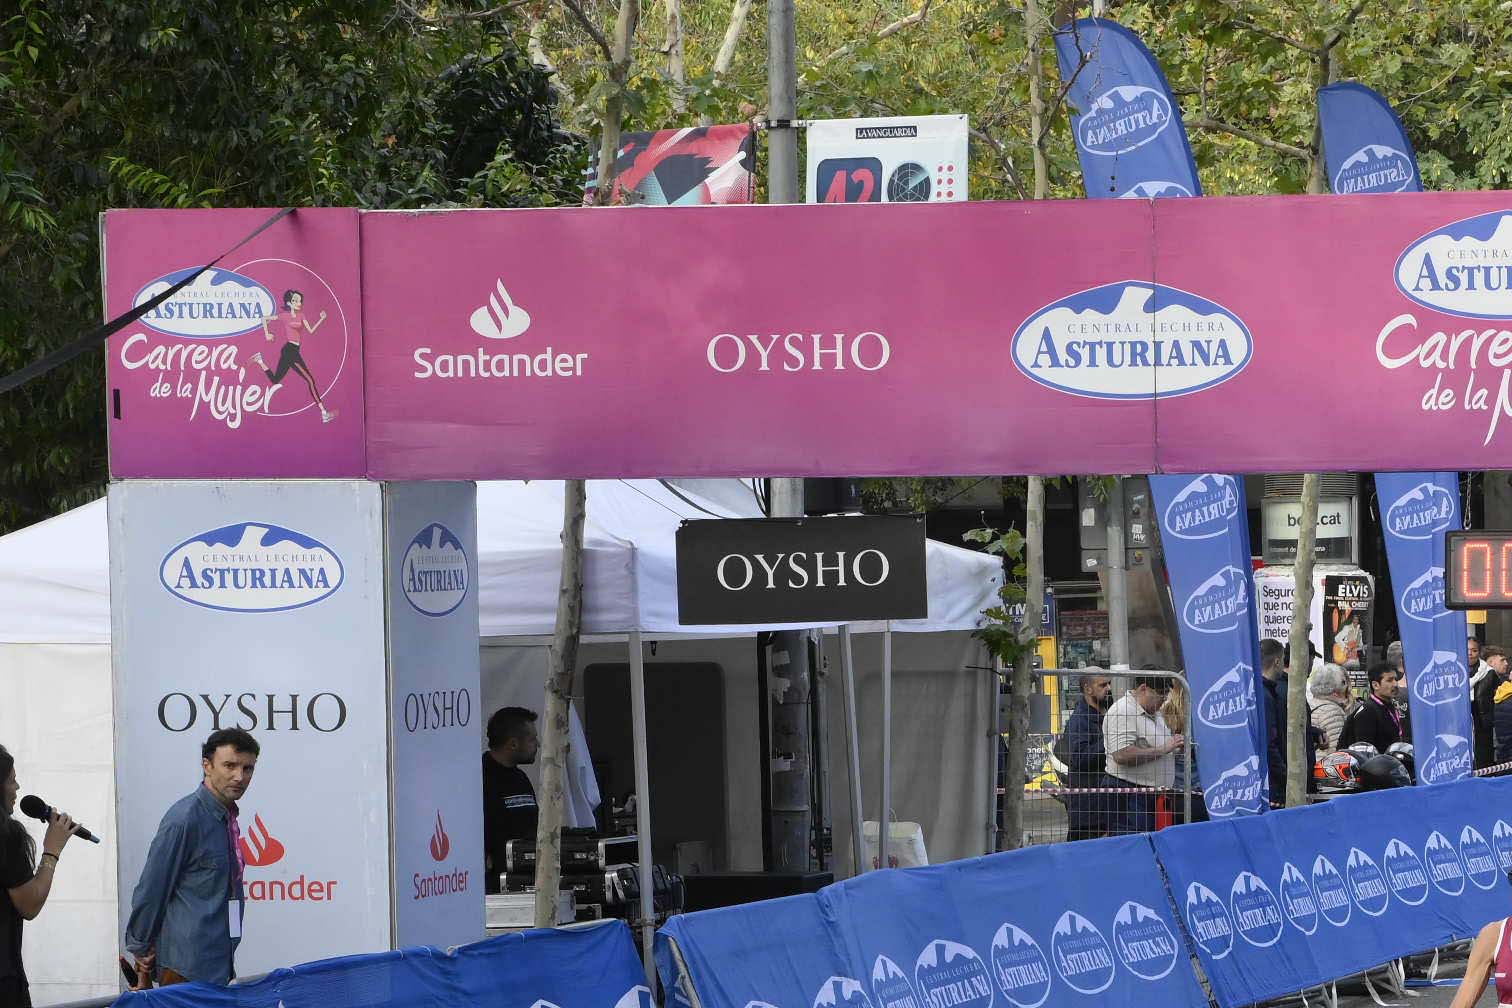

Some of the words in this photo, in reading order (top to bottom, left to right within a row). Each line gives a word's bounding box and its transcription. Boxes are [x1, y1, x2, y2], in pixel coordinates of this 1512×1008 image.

[1067, 322, 1143, 334] CENTRAL
[1150, 320, 1226, 333] LECHERA
[121, 333, 239, 370] Carrera
[414, 347, 588, 379] Santander
[706, 331, 891, 373] OYSHO
[1030, 325, 1235, 369] ASTURIANA
[150, 372, 172, 398] de
[176, 372, 193, 398] la
[190, 367, 283, 429] Mujer
[1421, 373, 1456, 411] de
[1464, 371, 1489, 411] la
[174, 556, 331, 590] ASTURIANA
[202, 554, 260, 563] CENTRAL
[266, 553, 325, 563] LECHERA
[717, 549, 890, 591] OYSHO
[407, 558, 466, 594] ASTURIANA
[1338, 585, 1369, 597] ELVIS
[1263, 601, 1280, 613] que
[157, 692, 348, 733] OYSHO
[404, 687, 472, 733] OYSHO
[241, 874, 337, 901] tander
[414, 866, 469, 900] Santander
[996, 958, 1048, 991] ASTURIANA
[1057, 945, 1112, 977] ASTURIANA
